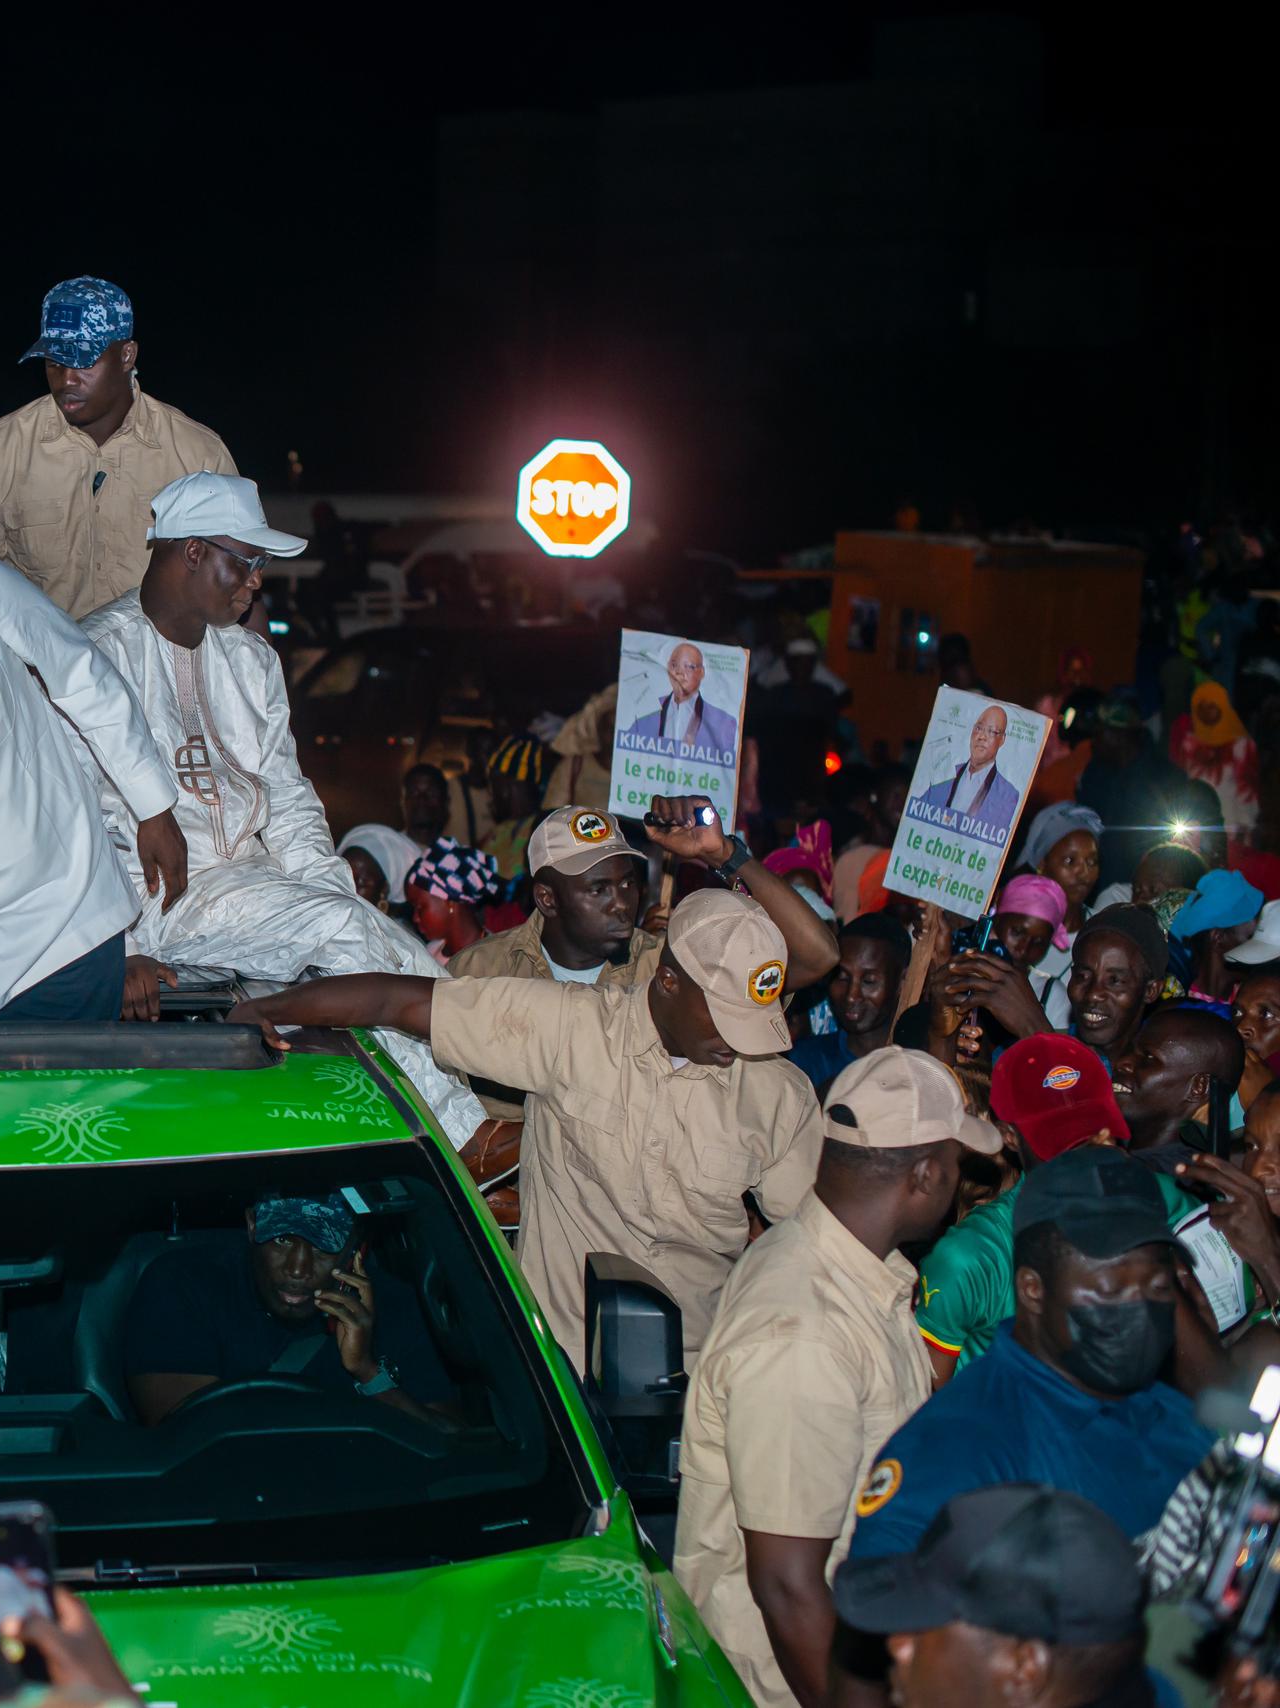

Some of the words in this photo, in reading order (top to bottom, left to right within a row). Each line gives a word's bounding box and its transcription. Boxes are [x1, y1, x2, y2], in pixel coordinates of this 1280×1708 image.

[530, 478, 618, 518] STOP
[620, 731, 675, 755] KIKALA
[679, 743, 733, 765] DIALLO
[624, 758, 641, 777] le
[646, 763, 694, 787] choix
[698, 772, 719, 791] de
[909, 799, 958, 829] KIKALA
[960, 815, 1007, 843] DIALLO
[906, 827, 922, 850] le
[924, 836, 966, 865] choix
[967, 849, 987, 872] de
[359, 1115, 394, 1129] AK
